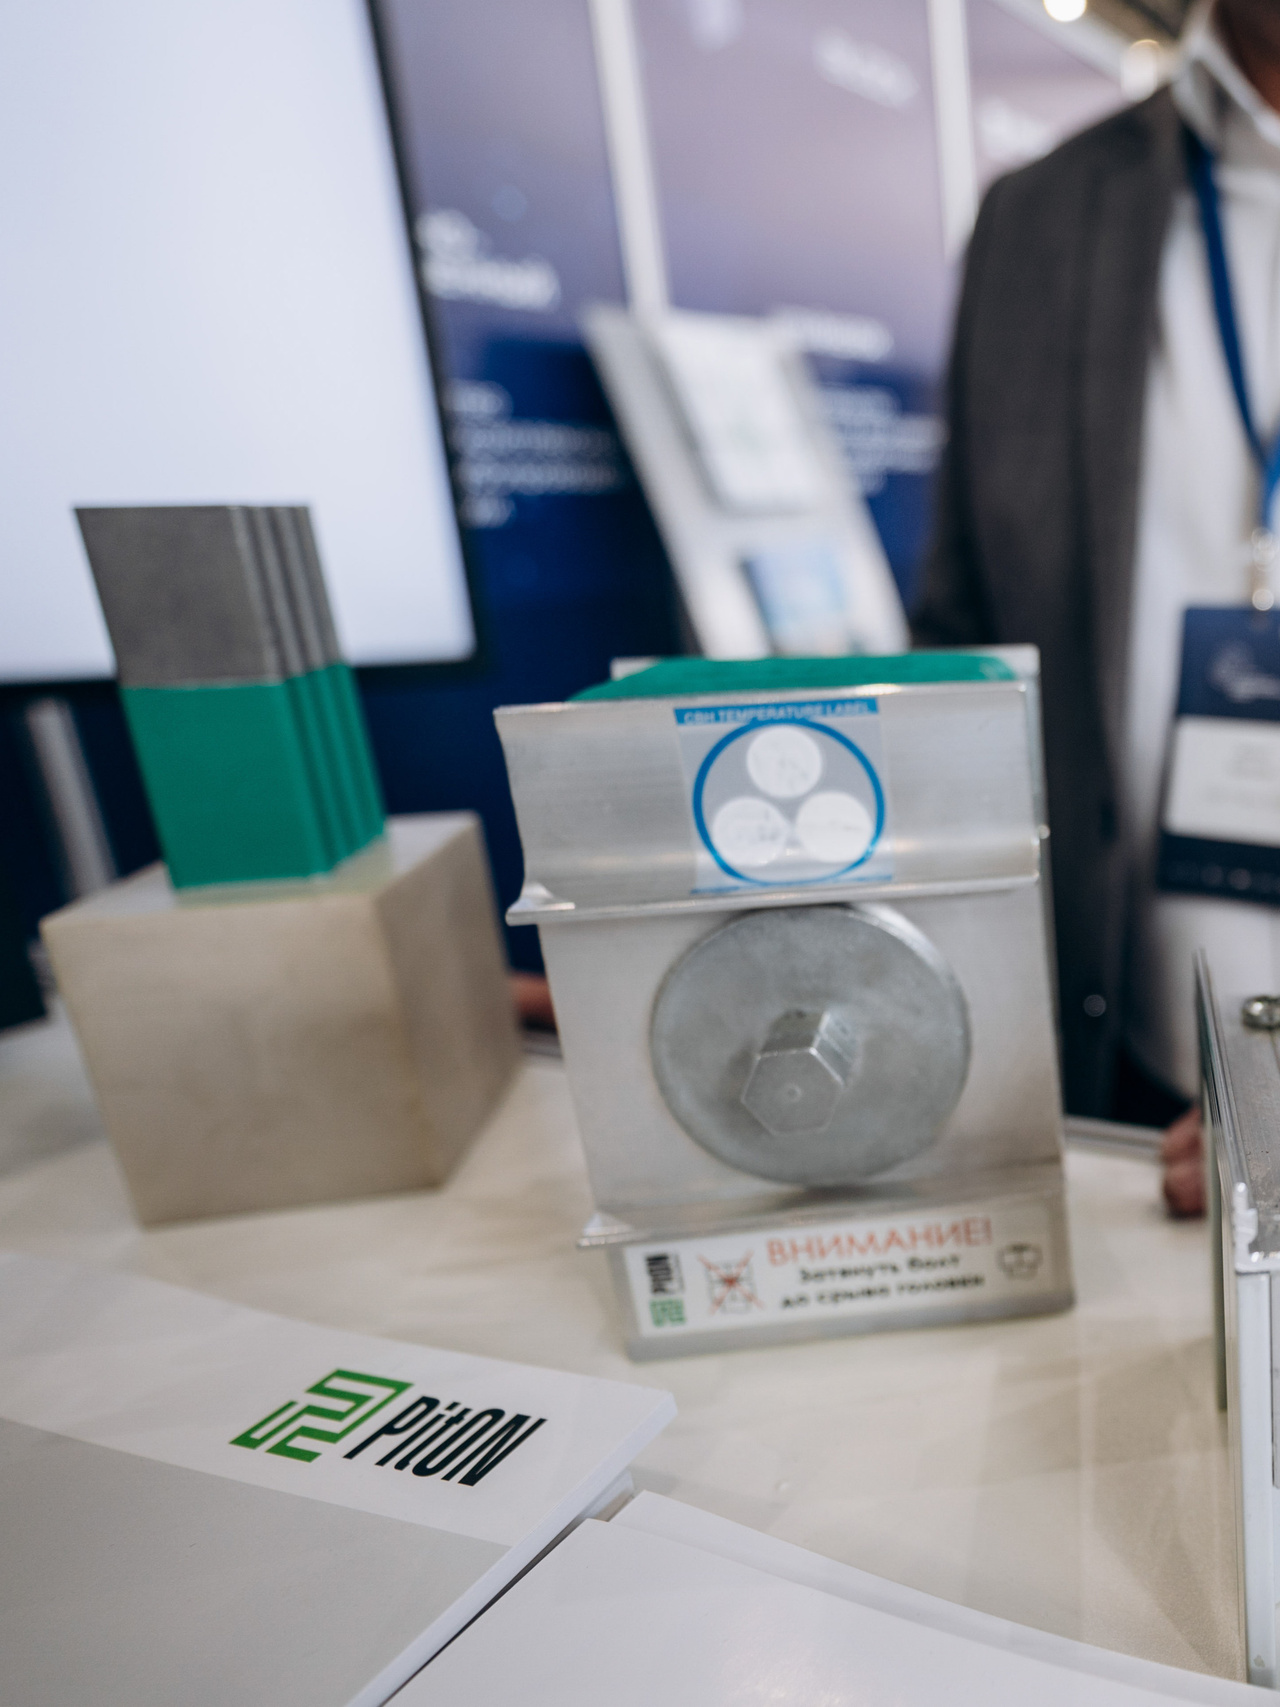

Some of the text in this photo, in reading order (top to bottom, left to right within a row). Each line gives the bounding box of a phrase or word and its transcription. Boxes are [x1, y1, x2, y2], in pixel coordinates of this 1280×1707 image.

[718, 704, 823, 724] TEMPERATURE
[825, 702, 869, 717] LABEL
[766, 1216, 993, 1267] ВНИМАНИЕ!
[342, 1396, 547, 1487] PitON
